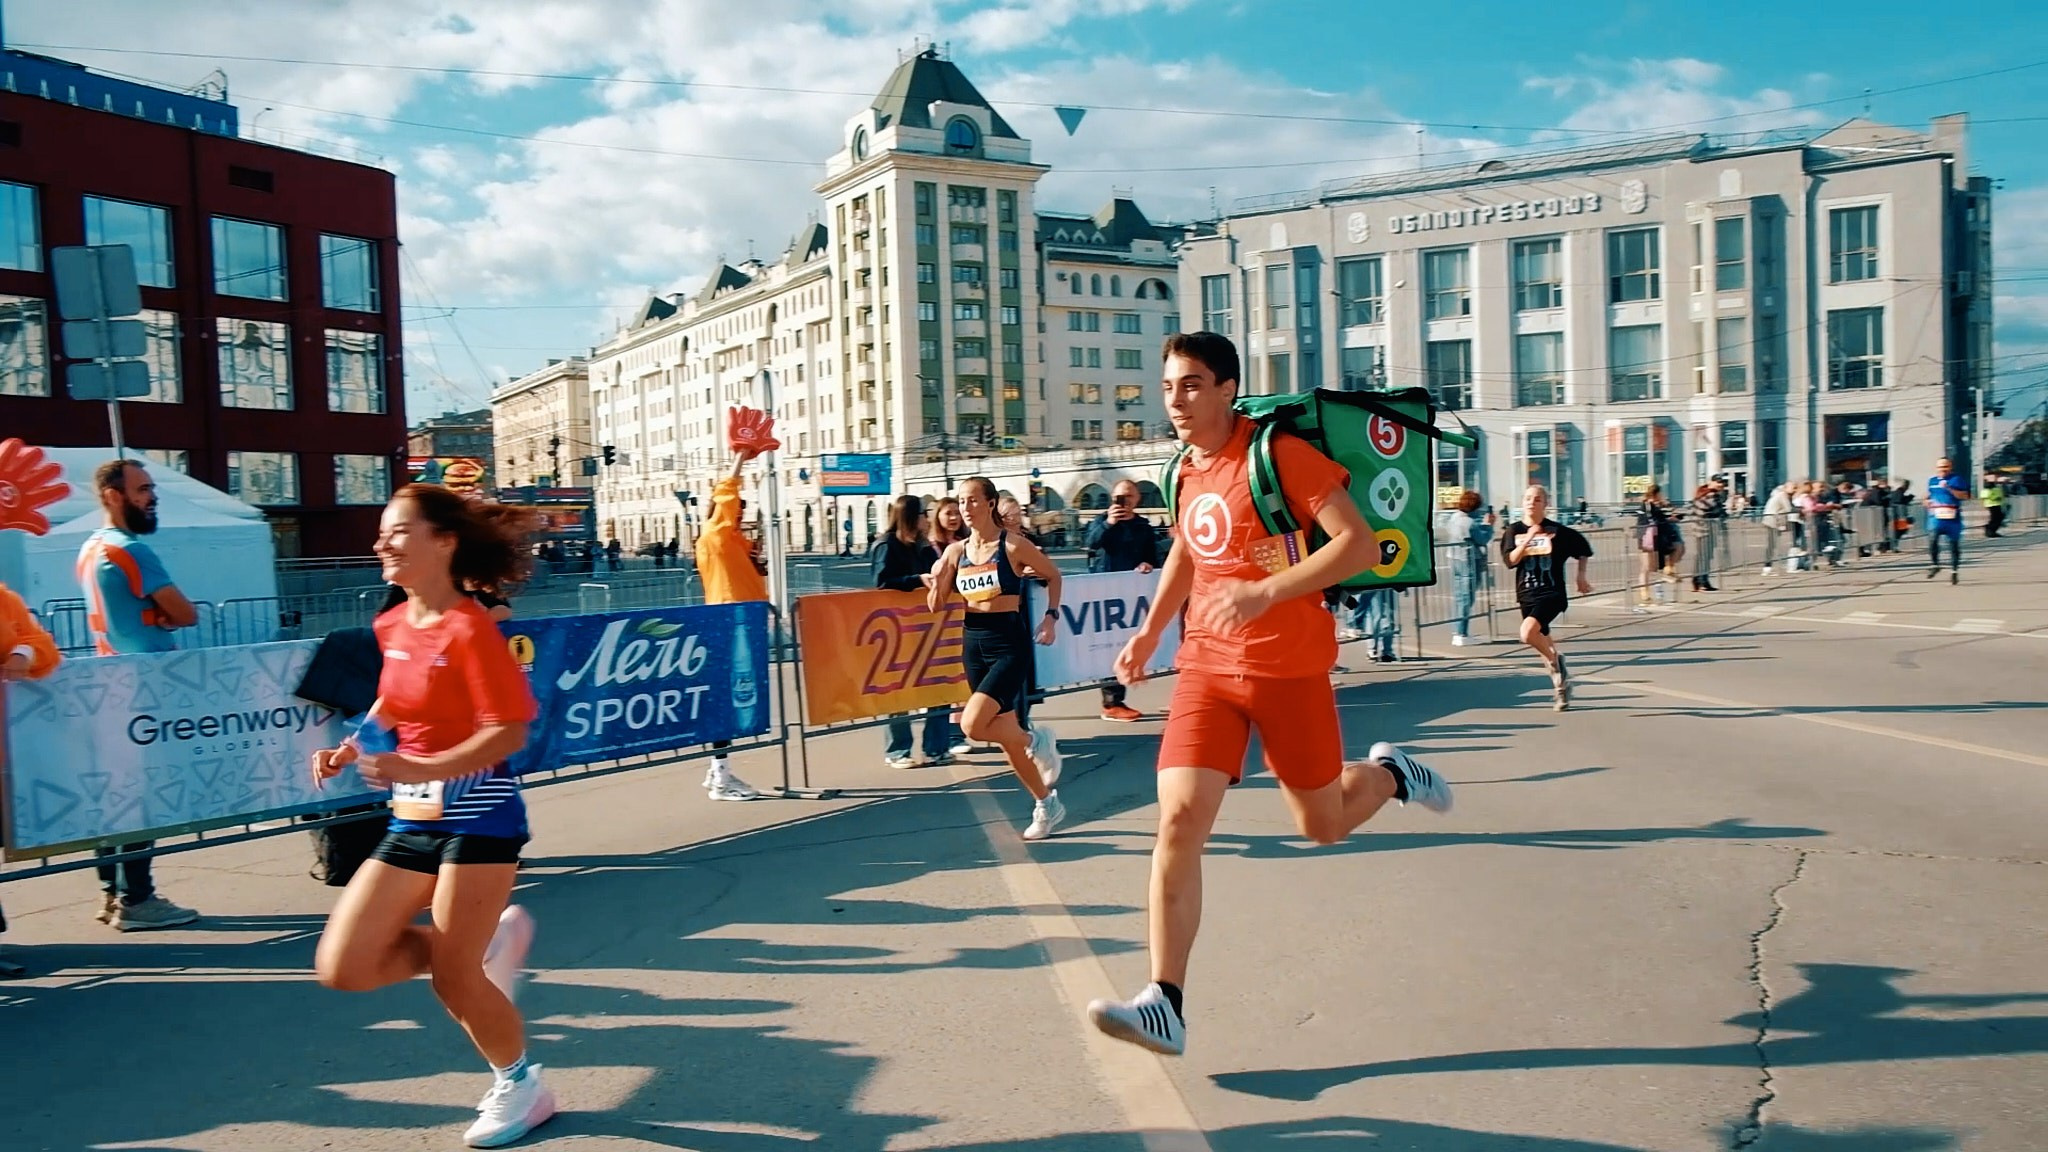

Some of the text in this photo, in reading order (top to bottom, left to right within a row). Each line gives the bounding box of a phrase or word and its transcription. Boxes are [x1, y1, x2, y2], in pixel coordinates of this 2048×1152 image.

[1388, 193, 1600, 234] ОБЛПОТРЕБСОЮЗ
[960, 574, 994, 591] 2044
[556, 618, 707, 690] Лель
[127, 704, 310, 746] Greenway
[565, 685, 710, 739] SPORT
[193, 738, 277, 755] GLOBAL
